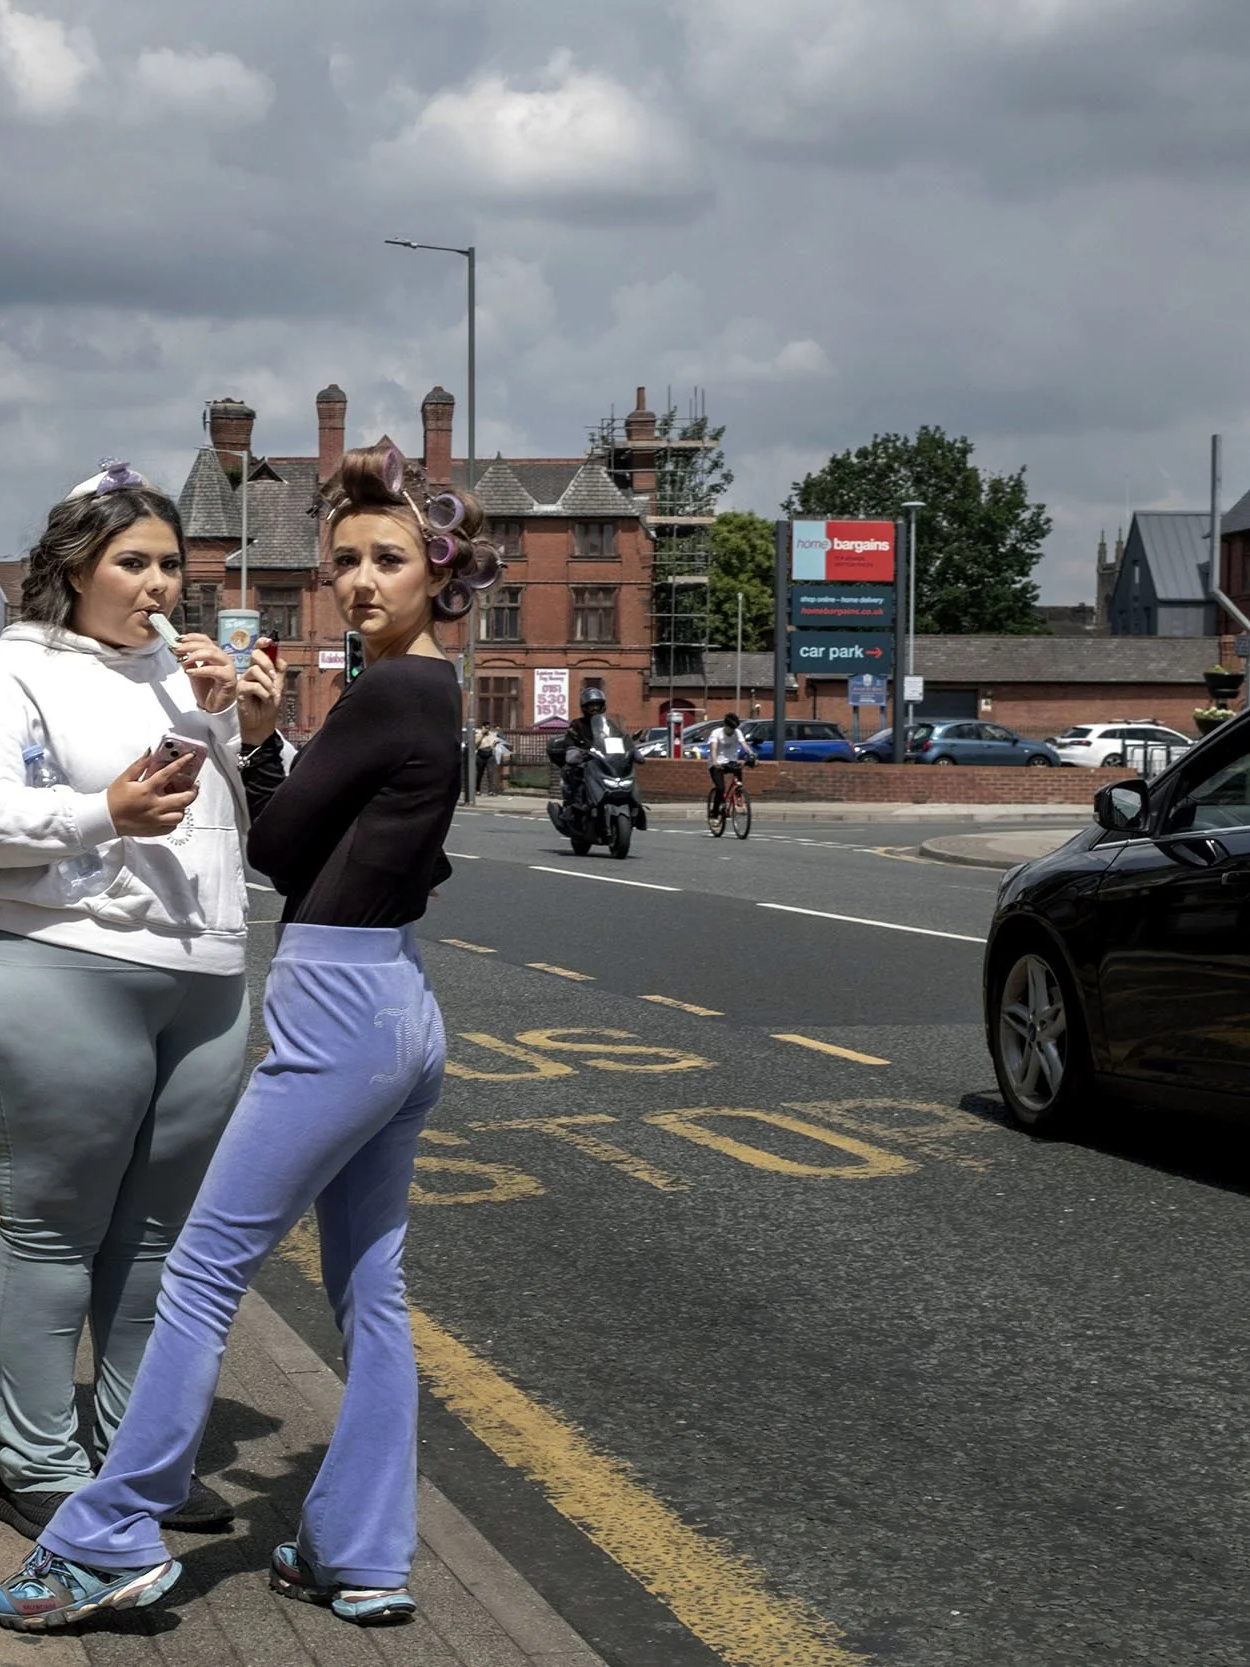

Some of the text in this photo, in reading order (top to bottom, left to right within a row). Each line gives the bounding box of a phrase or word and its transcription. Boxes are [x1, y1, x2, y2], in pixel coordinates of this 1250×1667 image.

[796, 538, 890, 553] home bargains
[860, 597, 884, 605] delivery
[801, 607, 884, 616] homebargains.co.uk
[799, 645, 864, 661] car park
[537, 694, 566, 704] 530
[536, 705, 567, 715] 1516
[446, 1027, 718, 1081] US
